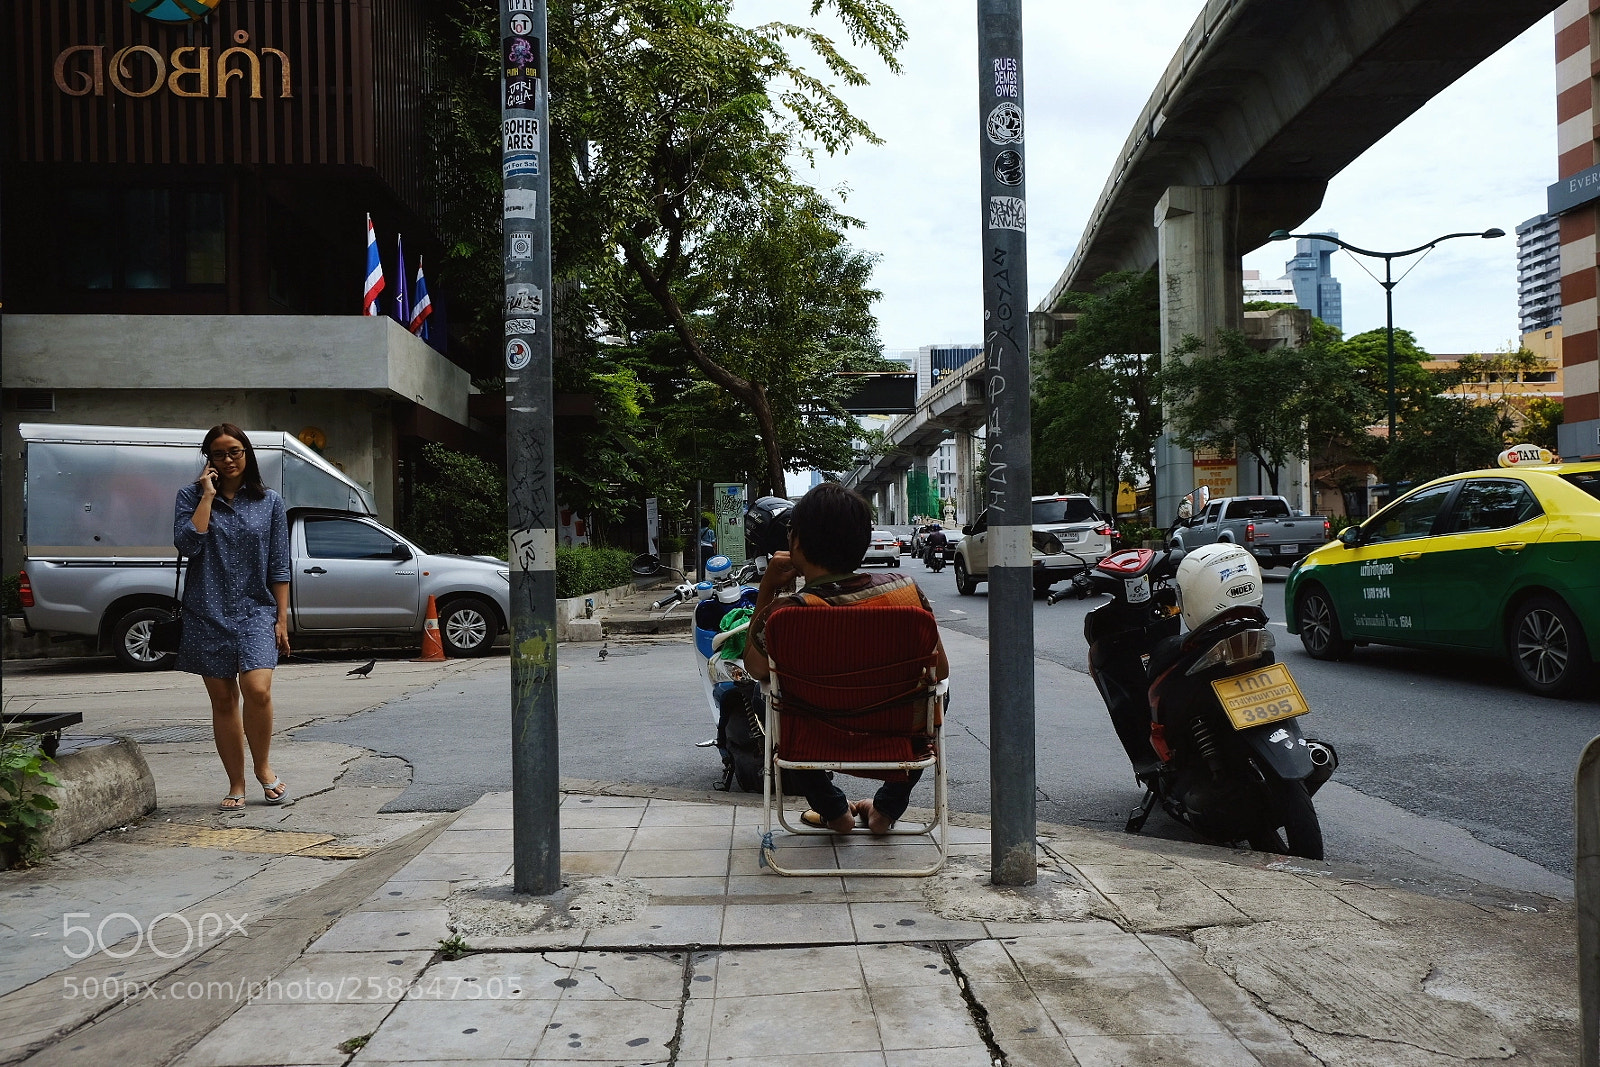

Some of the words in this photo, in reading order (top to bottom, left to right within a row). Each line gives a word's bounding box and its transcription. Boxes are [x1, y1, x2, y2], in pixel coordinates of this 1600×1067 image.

[53, 30, 293, 98] ดอยคำ
[505, 119, 538, 135] BOHER
[507, 134, 533, 151] ARES
[1569, 172, 1600, 193] EVER
[1517, 449, 1541, 461] TAXI
[1230, 583, 1253, 596] INDEX
[1399, 615, 1412, 628] 1584
[1242, 700, 1293, 723] 3895
